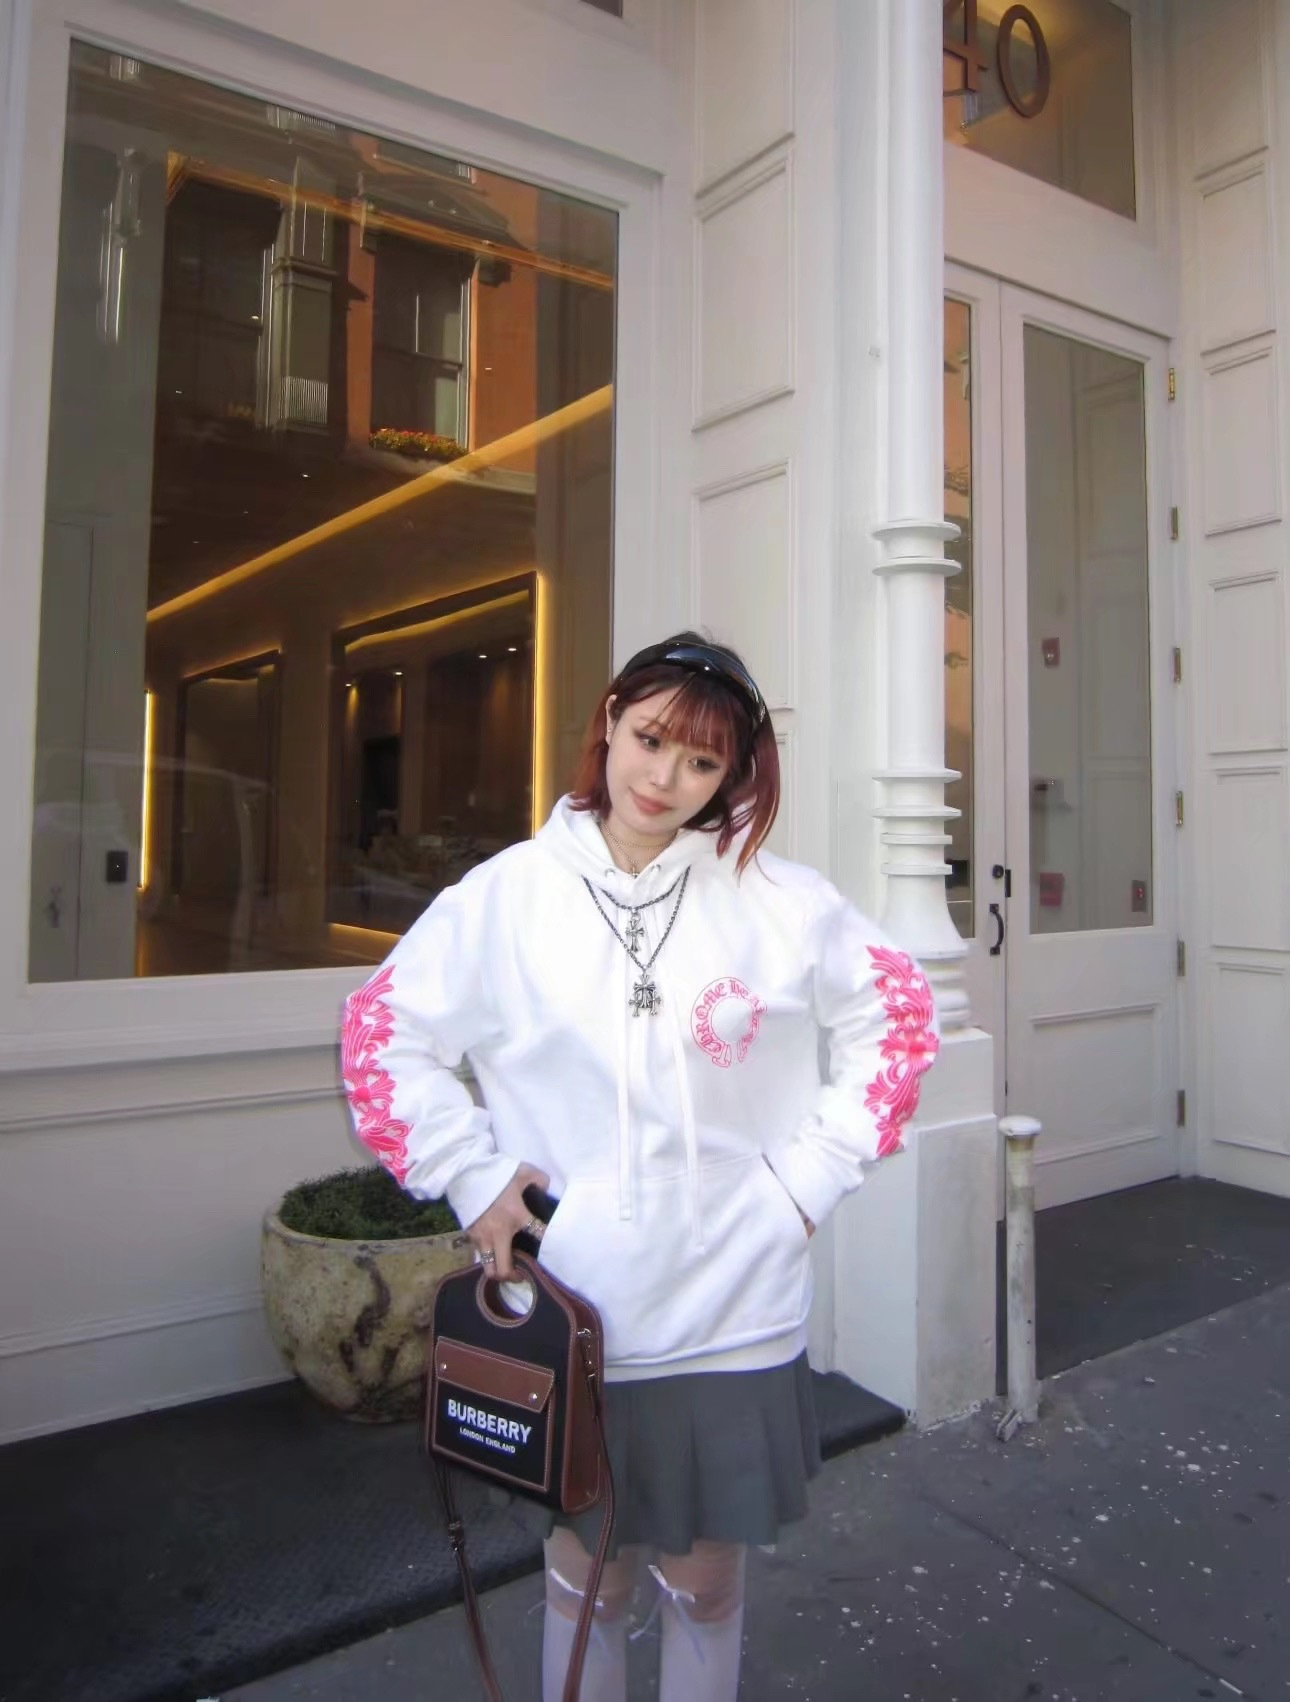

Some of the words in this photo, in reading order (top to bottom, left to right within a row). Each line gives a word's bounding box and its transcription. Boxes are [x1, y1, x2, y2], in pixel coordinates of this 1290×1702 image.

[447, 1398, 532, 1443] BURBERRY
[459, 1427, 484, 1443] LONDON
[485, 1437, 516, 1454] ENGLAND
